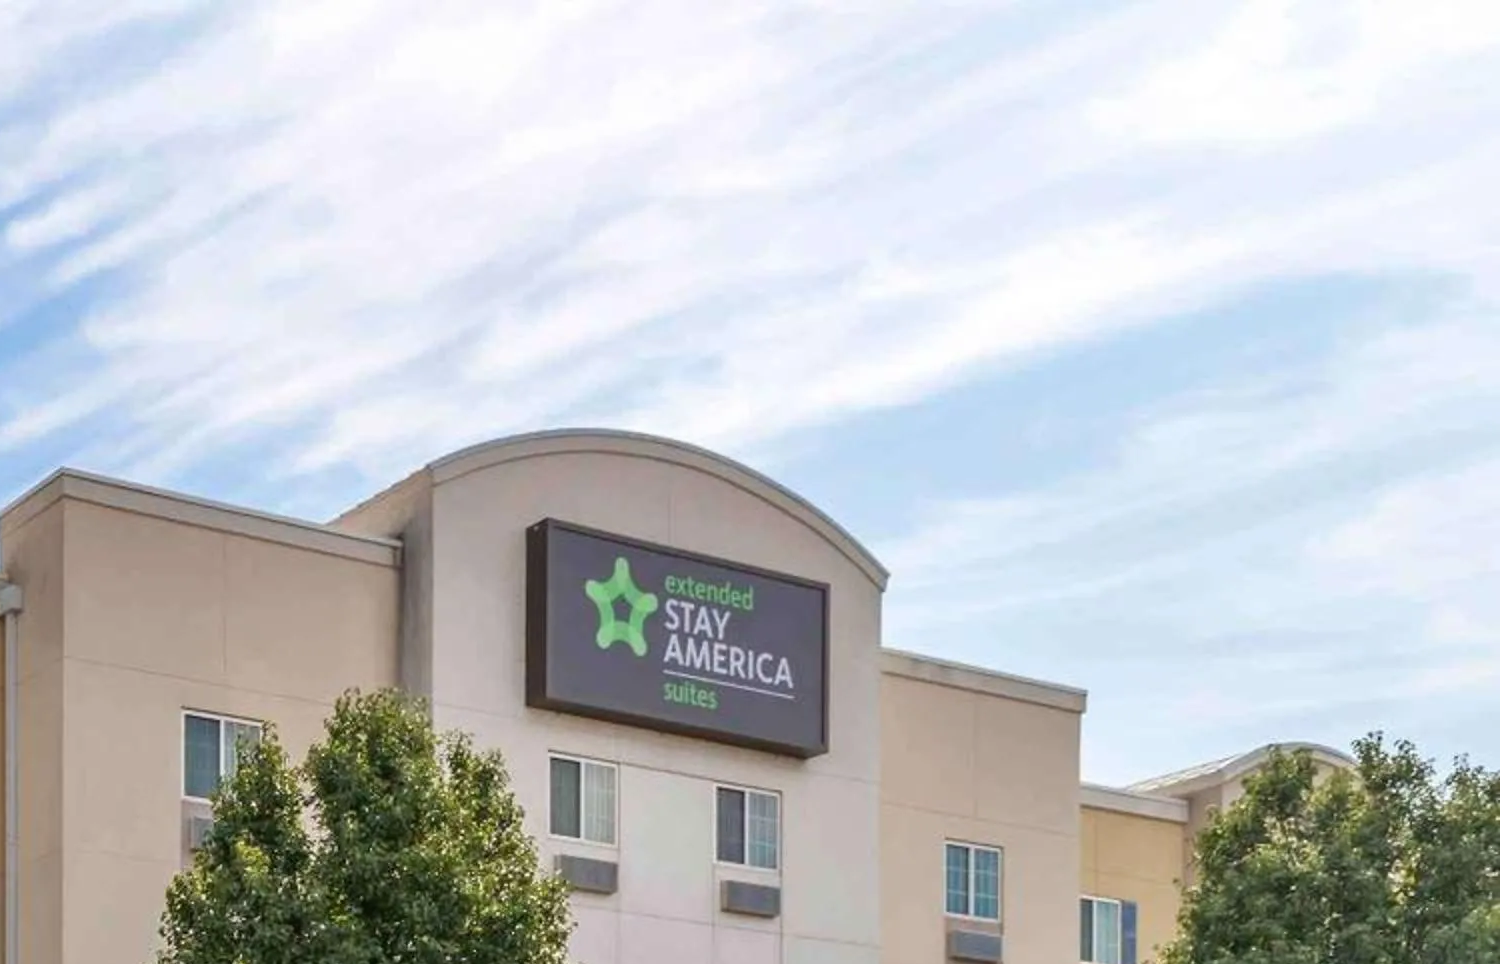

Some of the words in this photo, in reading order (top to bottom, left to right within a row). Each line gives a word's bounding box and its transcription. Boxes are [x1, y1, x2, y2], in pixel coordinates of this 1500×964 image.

[664, 575, 754, 611] extended
[664, 598, 731, 641] STAY
[663, 633, 794, 689] AMERICA
[663, 681, 718, 710] suites
